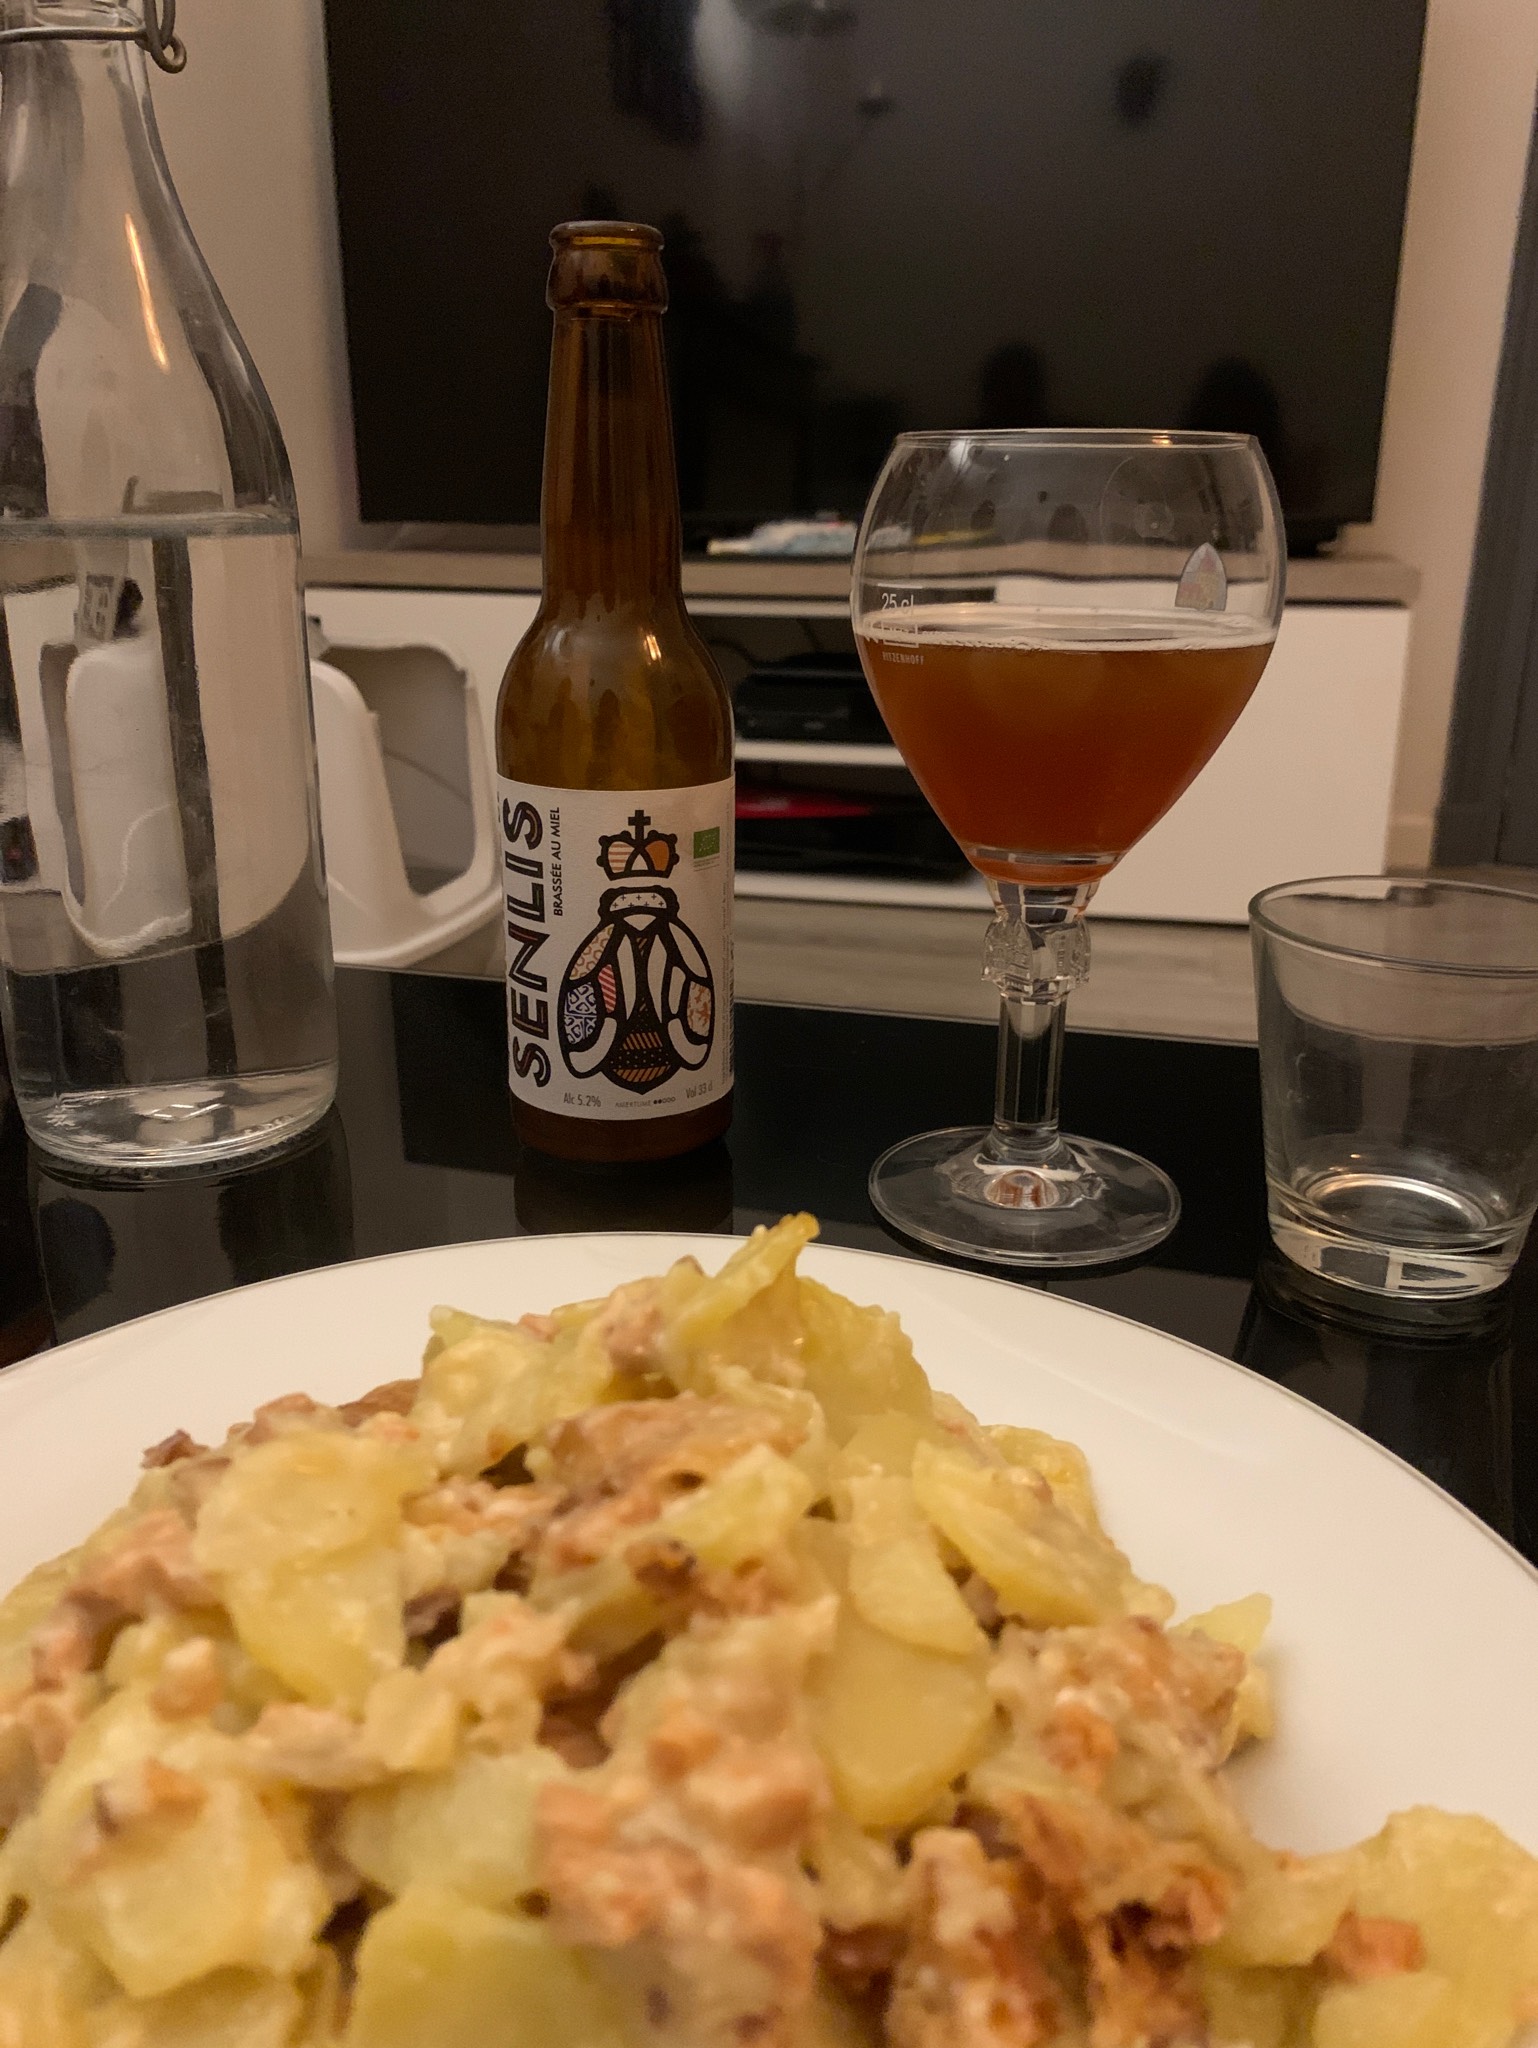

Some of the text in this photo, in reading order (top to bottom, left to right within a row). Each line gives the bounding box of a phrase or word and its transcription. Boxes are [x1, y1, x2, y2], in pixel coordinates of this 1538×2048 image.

[882, 593, 897, 611] 25
[550, 807, 563, 916] BRASSÉE AU MIEL
[502, 797, 552, 1088] SENLIS
[685, 1087, 697, 1099] Vol
[698, 1083, 708, 1096] 33
[564, 1093, 602, 1108] Alc 5.2%
